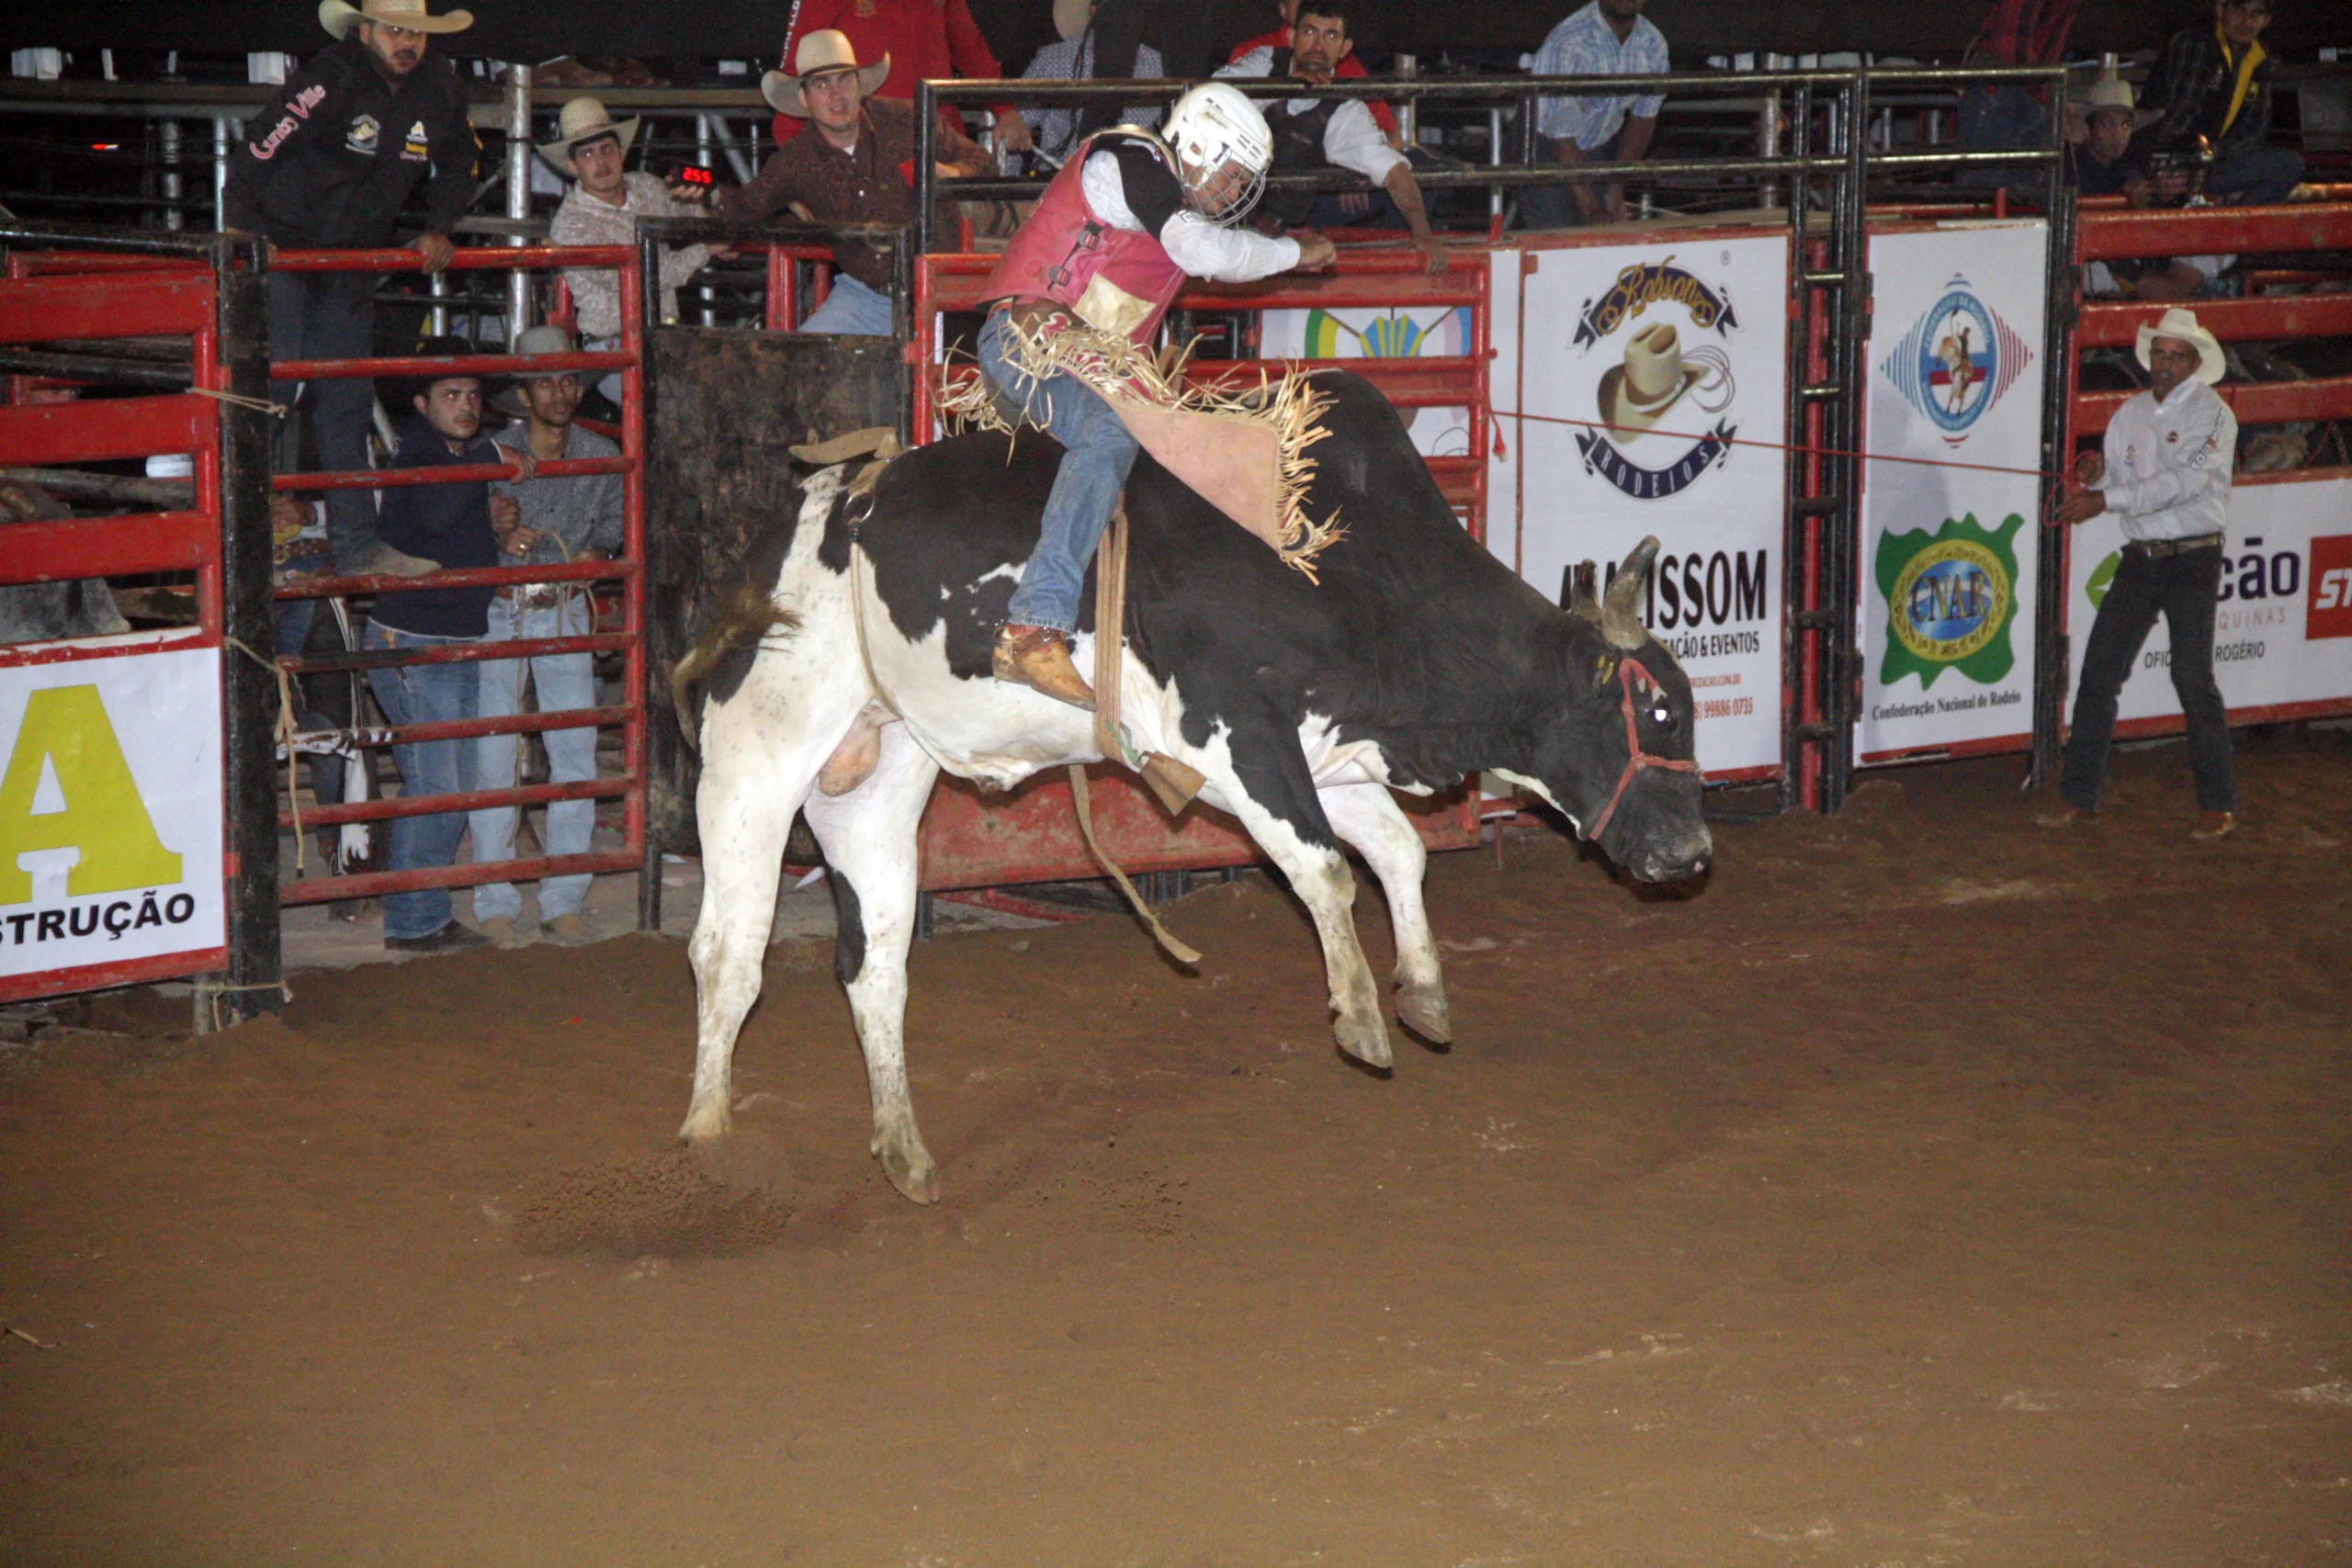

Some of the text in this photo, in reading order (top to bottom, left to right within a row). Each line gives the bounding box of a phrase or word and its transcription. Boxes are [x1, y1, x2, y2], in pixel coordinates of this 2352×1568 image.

[1600, 446, 1709, 496] RODEIOS
[1701, 636, 1709, 657] &
[1711, 631, 1760, 656] EVENTOS
[2215, 638, 2266, 662] ROGÉRIO
[1871, 688, 2021, 721] Confederação Nacional de Rodeio
[0, 890, 195, 944] TRUÇÃO
